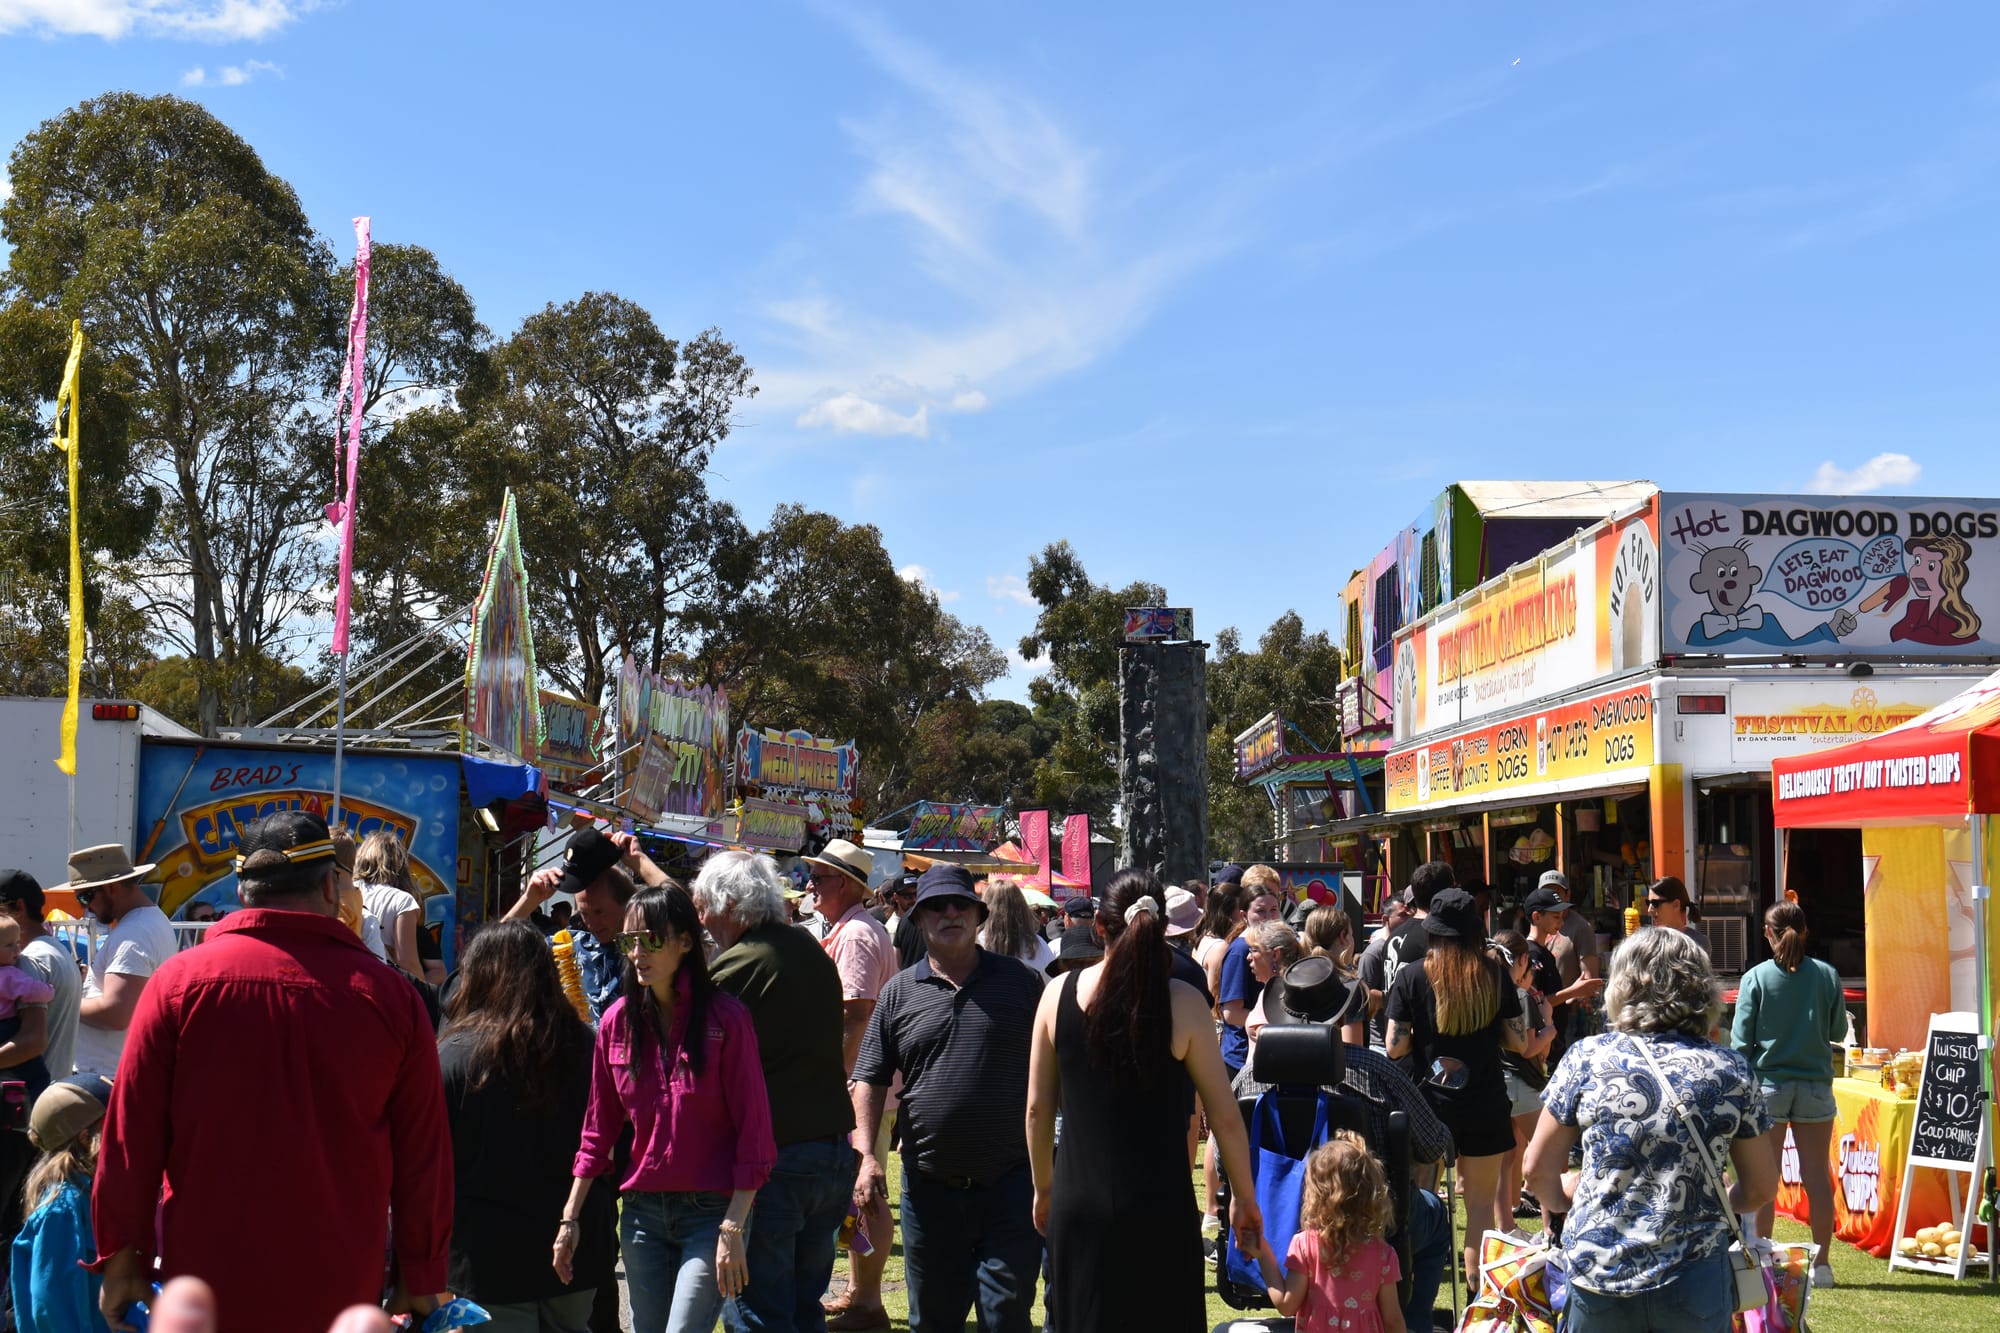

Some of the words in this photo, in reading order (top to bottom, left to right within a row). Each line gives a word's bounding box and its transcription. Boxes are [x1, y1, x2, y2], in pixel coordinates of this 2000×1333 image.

[1669, 508, 1729, 545] Hot
[1741, 509, 1898, 537] DAGWOOD
[1909, 511, 1999, 539] DOGS
[1777, 550, 1814, 577] LETS
[1818, 549, 1849, 564] EAT
[1863, 538, 1893, 566] THATS
[1872, 546, 1900, 573] BIG
[1611, 543, 1627, 617] HOT
[1631, 533, 1654, 604] FOOD
[1784, 565, 1863, 593] DAGWOOD
[1806, 586, 1847, 606] DOG
[1437, 614, 1496, 686] FESTIVAL
[1499, 574, 1577, 662] CATERING
[1592, 693, 1647, 731] DAGWOOD
[1734, 714, 1853, 735] FESTIVAL
[1497, 725, 1528, 754] CORN
[1546, 725, 1562, 764] HOT
[1564, 719, 1588, 759] CHIPS
[1605, 734, 1635, 765] DOGS
[210, 762, 304, 792] BRAD'S
[1430, 768, 1450, 791] COFFEE
[1464, 763, 1489, 787] DONUTS
[1497, 754, 1528, 783] DOGS
[1778, 768, 1832, 800] DELICIOUSLY
[1833, 762, 1863, 793] TASTY
[1863, 760, 1884, 789] HOT
[1885, 756, 1927, 788] TWISTED
[1928, 752, 1961, 785] CHIPS
[1933, 1036, 1979, 1062] TWISTED
[1935, 1063, 1966, 1083] CHIP
[1918, 1120, 1944, 1140] COLD
[1945, 1126, 1978, 1146] DRINKS
[1930, 1143, 1946, 1158] $4
